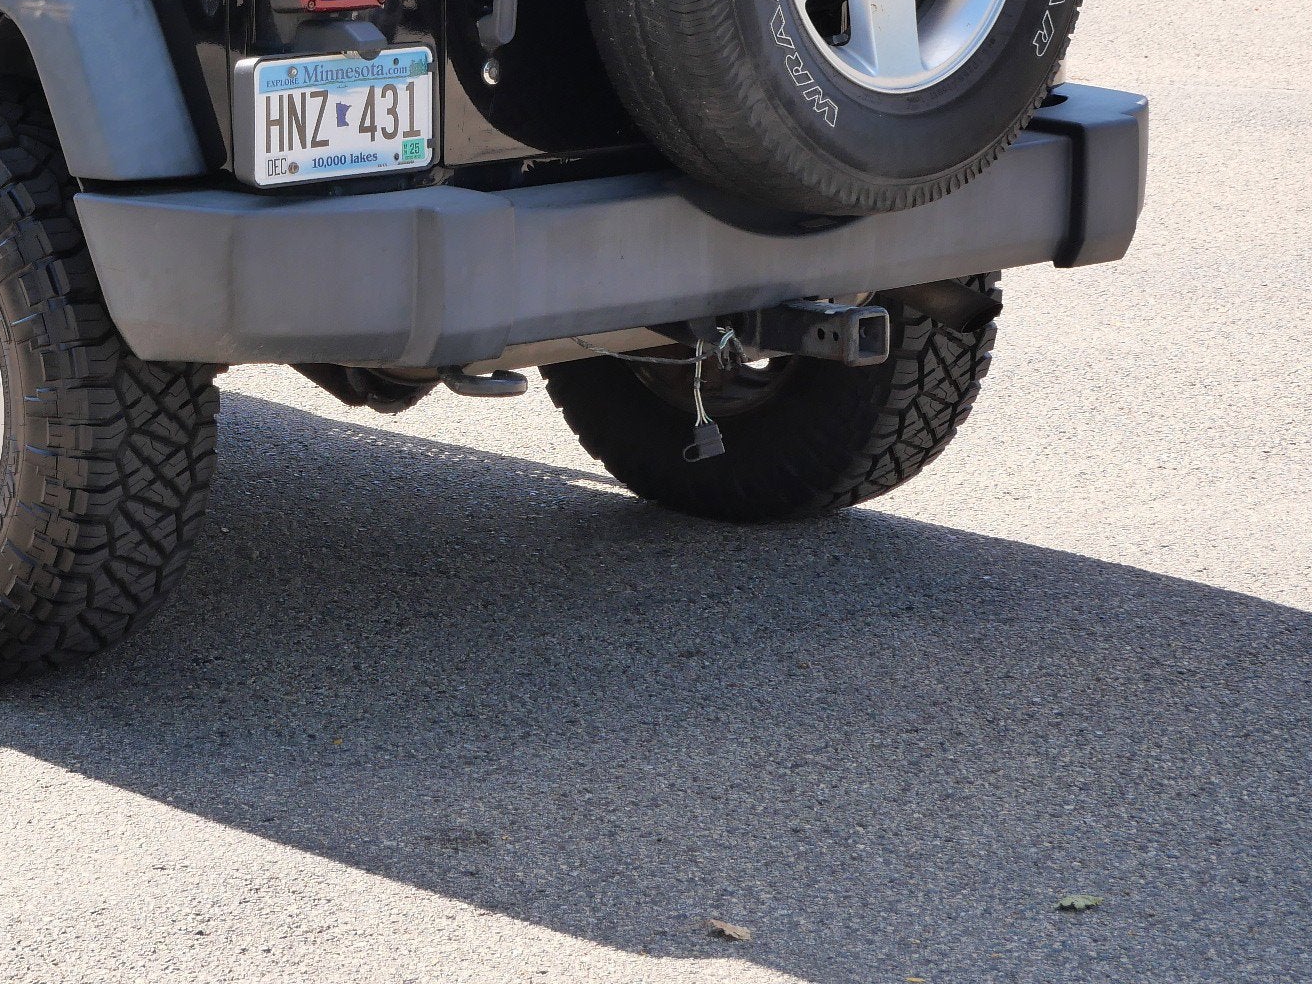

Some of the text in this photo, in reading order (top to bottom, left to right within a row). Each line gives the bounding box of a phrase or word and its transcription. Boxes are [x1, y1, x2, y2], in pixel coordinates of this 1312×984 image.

[266, 77, 300, 88] EXPLORE
[265, 81, 421, 154] HNZ 431
[409, 142, 420, 155] 25
[267, 157, 287, 177] DEC
[311, 152, 378, 169] 10,000 lakes
